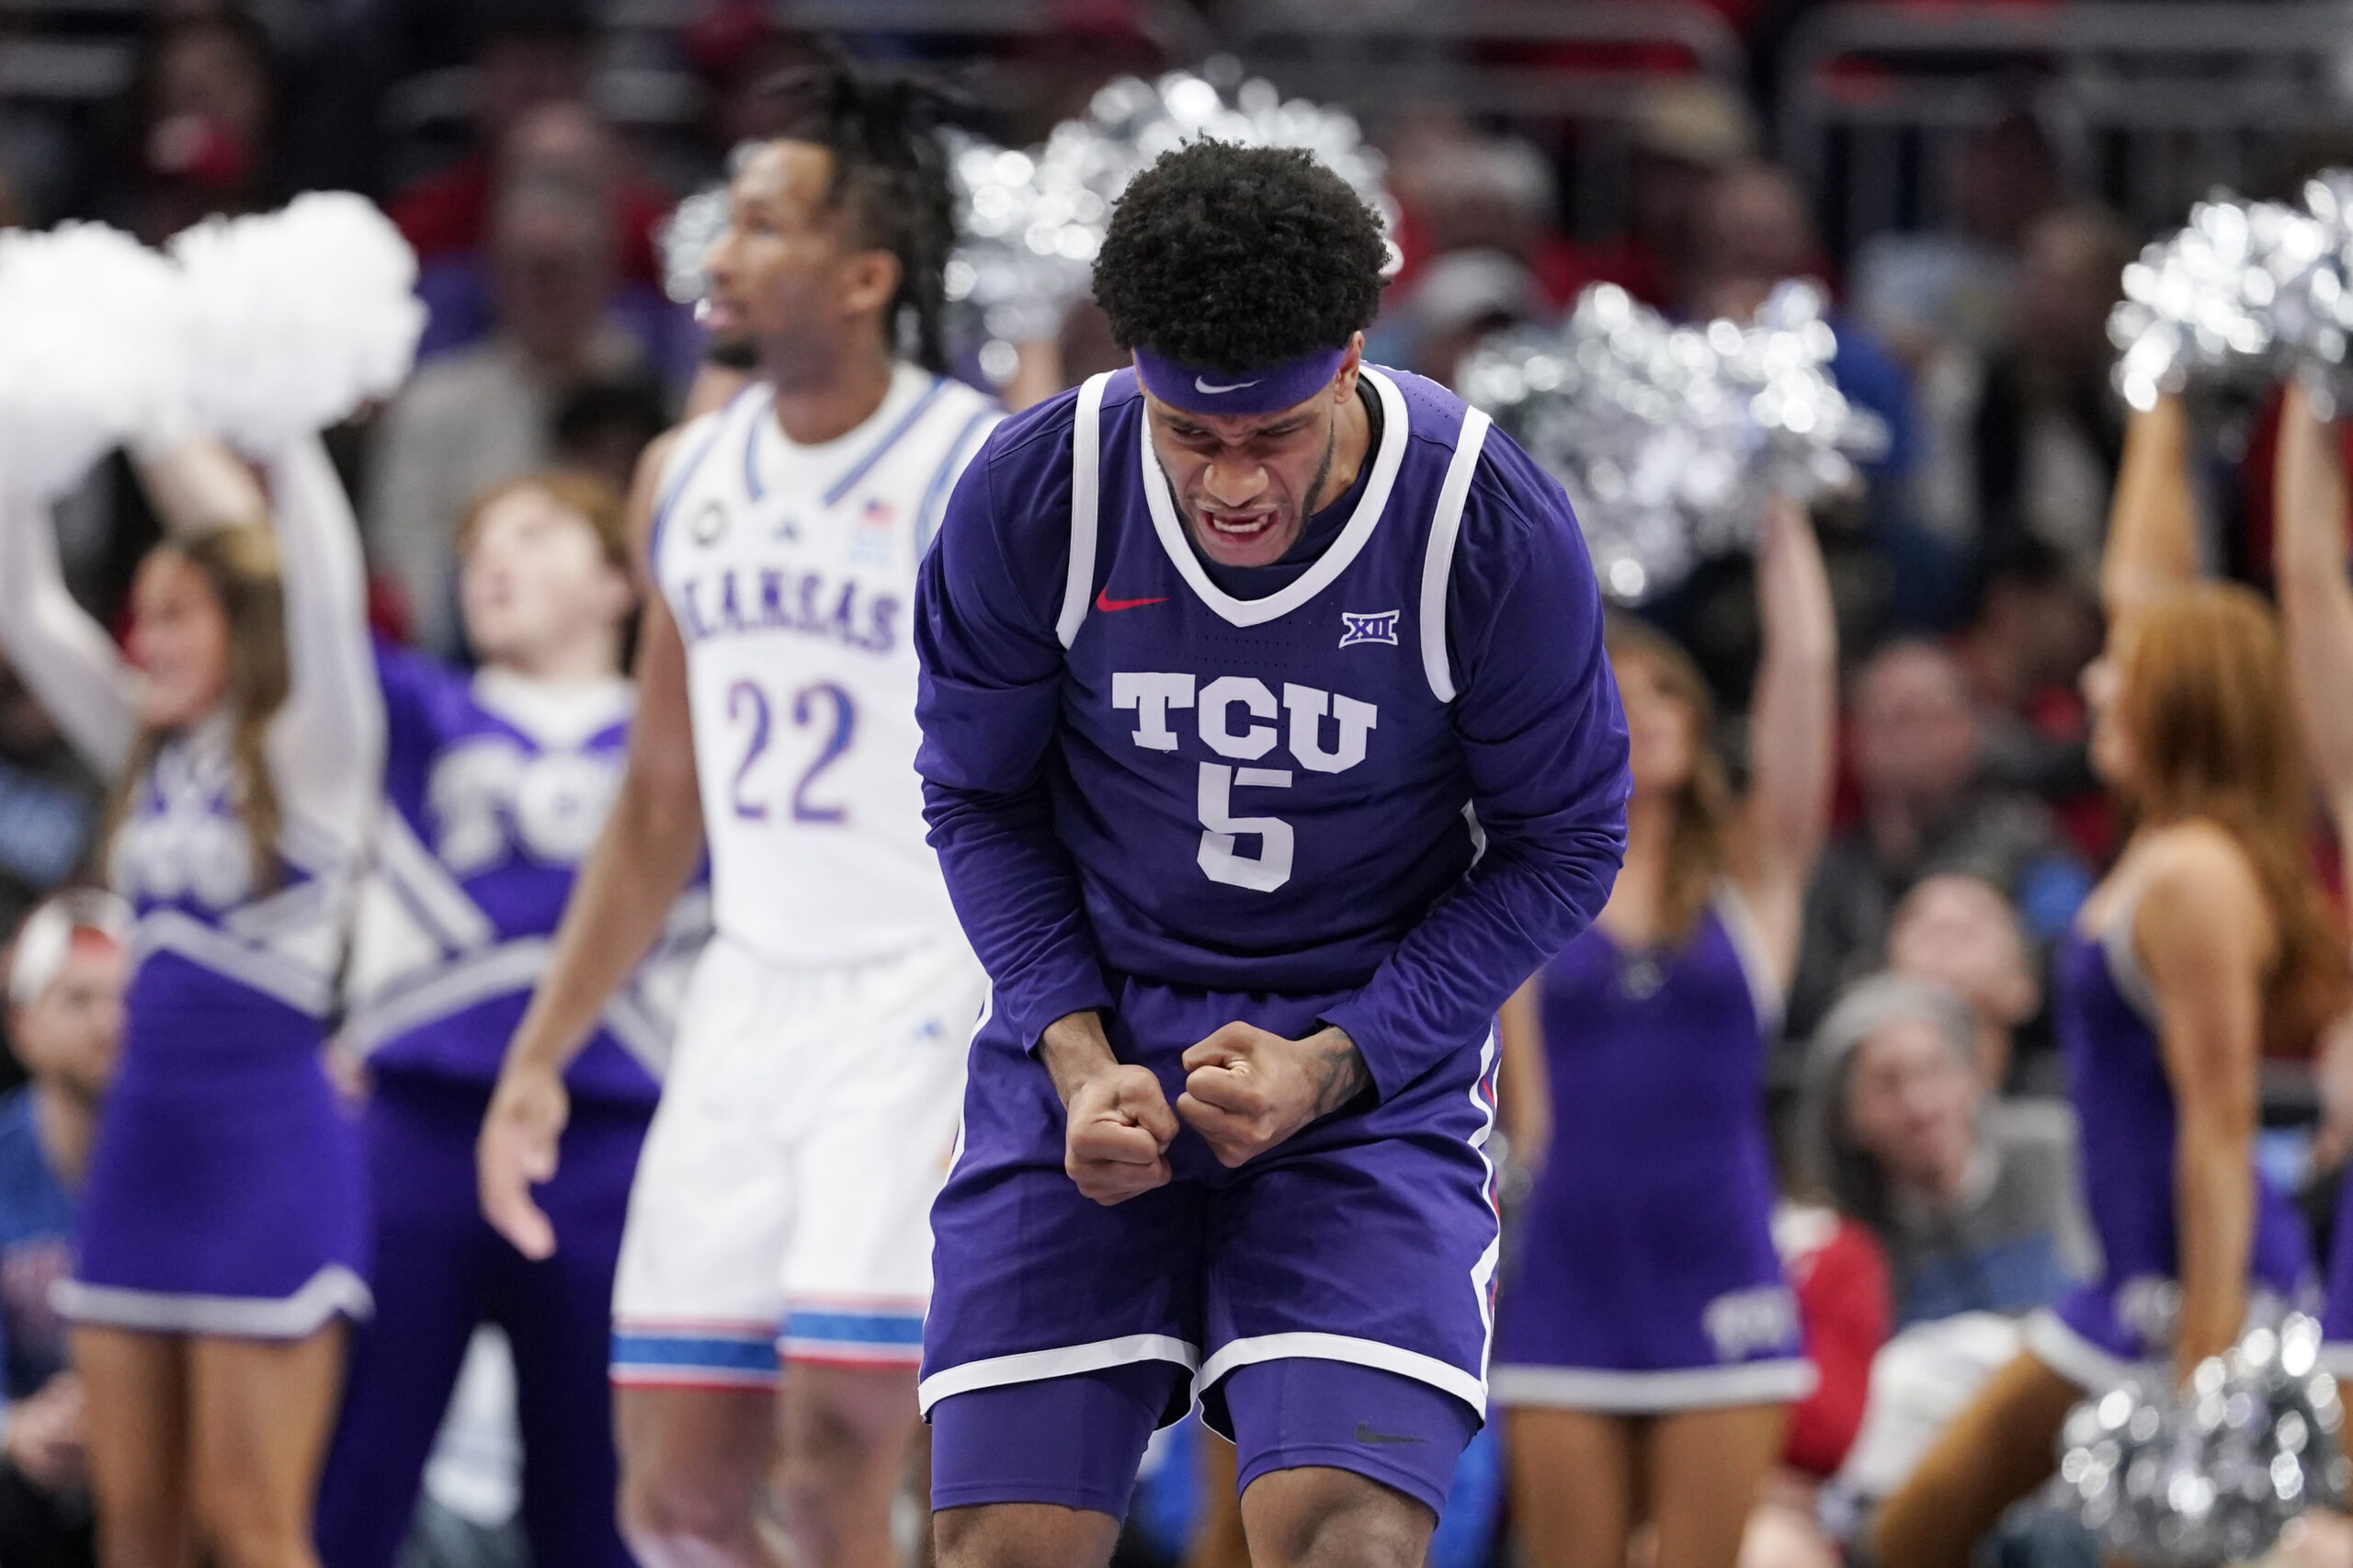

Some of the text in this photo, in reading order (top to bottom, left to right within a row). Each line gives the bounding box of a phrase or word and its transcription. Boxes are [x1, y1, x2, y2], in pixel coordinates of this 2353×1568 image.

[1342, 612, 1397, 644] XII
[729, 678, 856, 824] 22
[1111, 672, 1378, 774] TCU
[1197, 761, 1294, 893] 5
